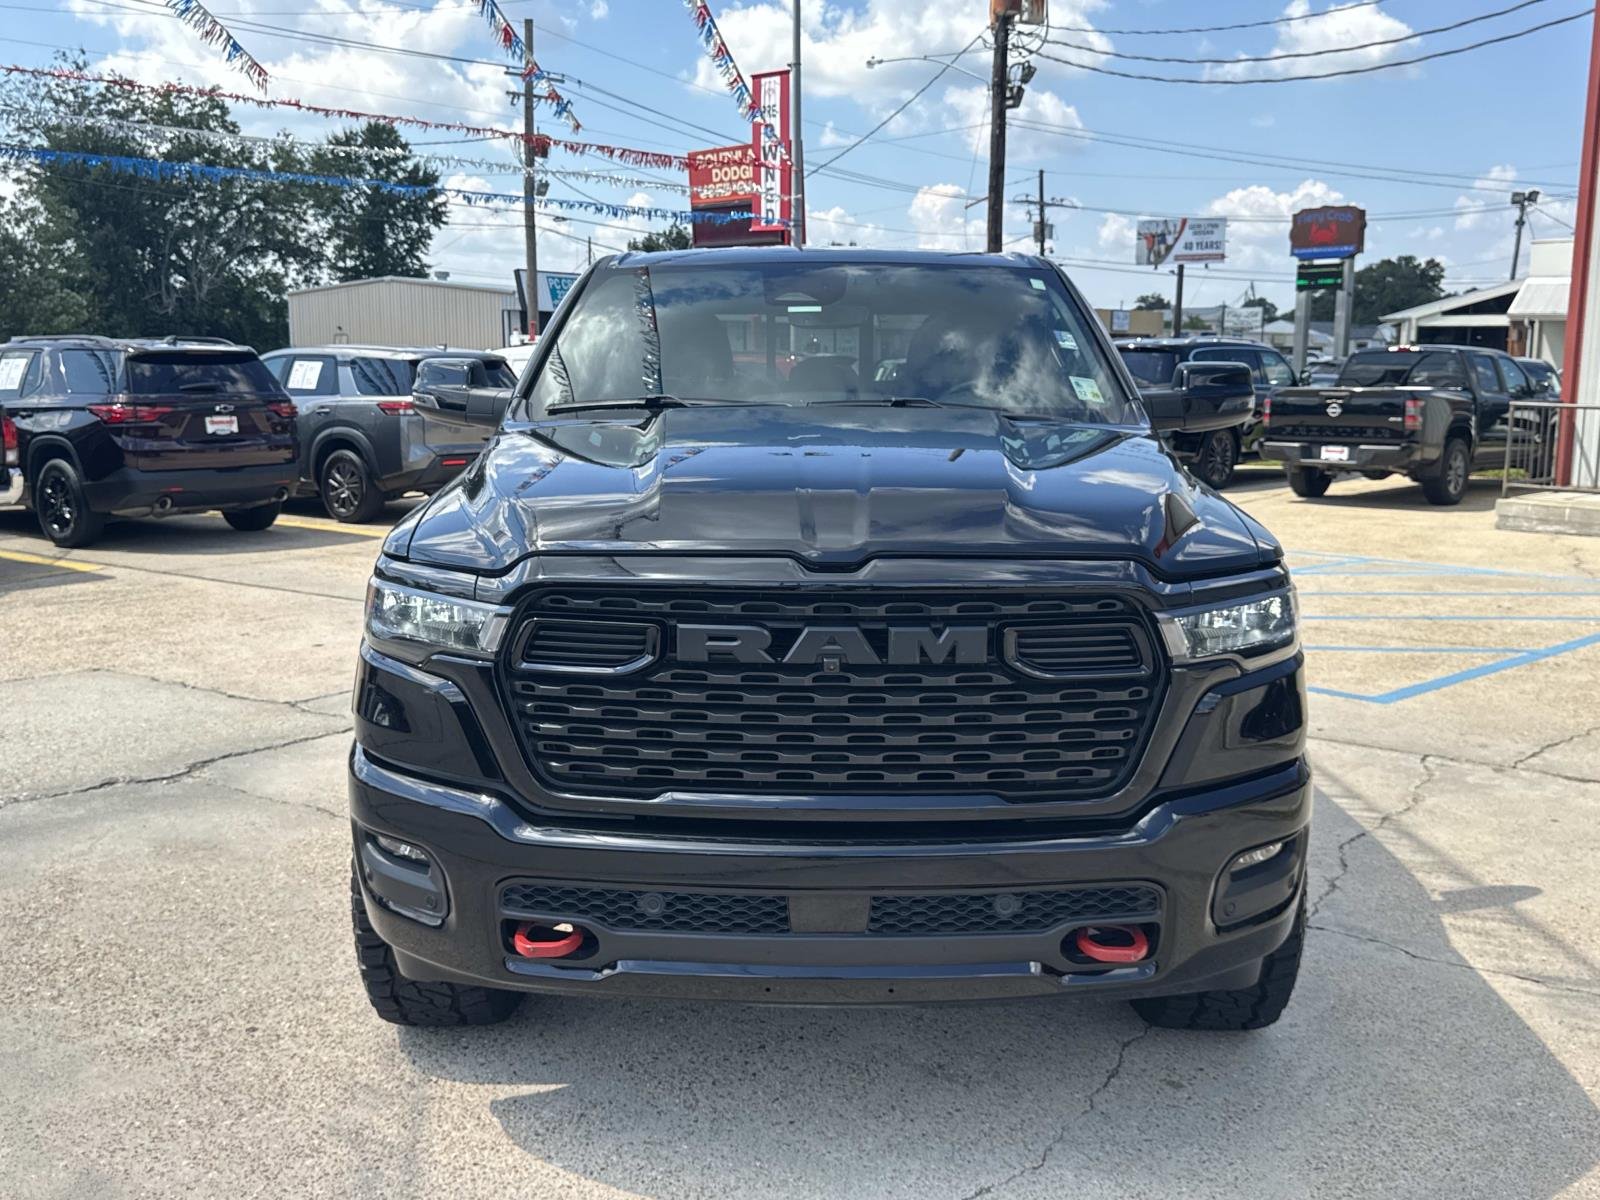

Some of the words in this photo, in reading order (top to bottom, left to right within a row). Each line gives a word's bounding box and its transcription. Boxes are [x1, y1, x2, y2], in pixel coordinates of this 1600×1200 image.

[1183, 241, 1194, 251] 40
[1195, 240, 1222, 251] YEARS!
[548, 277, 561, 290] PC
[676, 623, 988, 664] RAM
